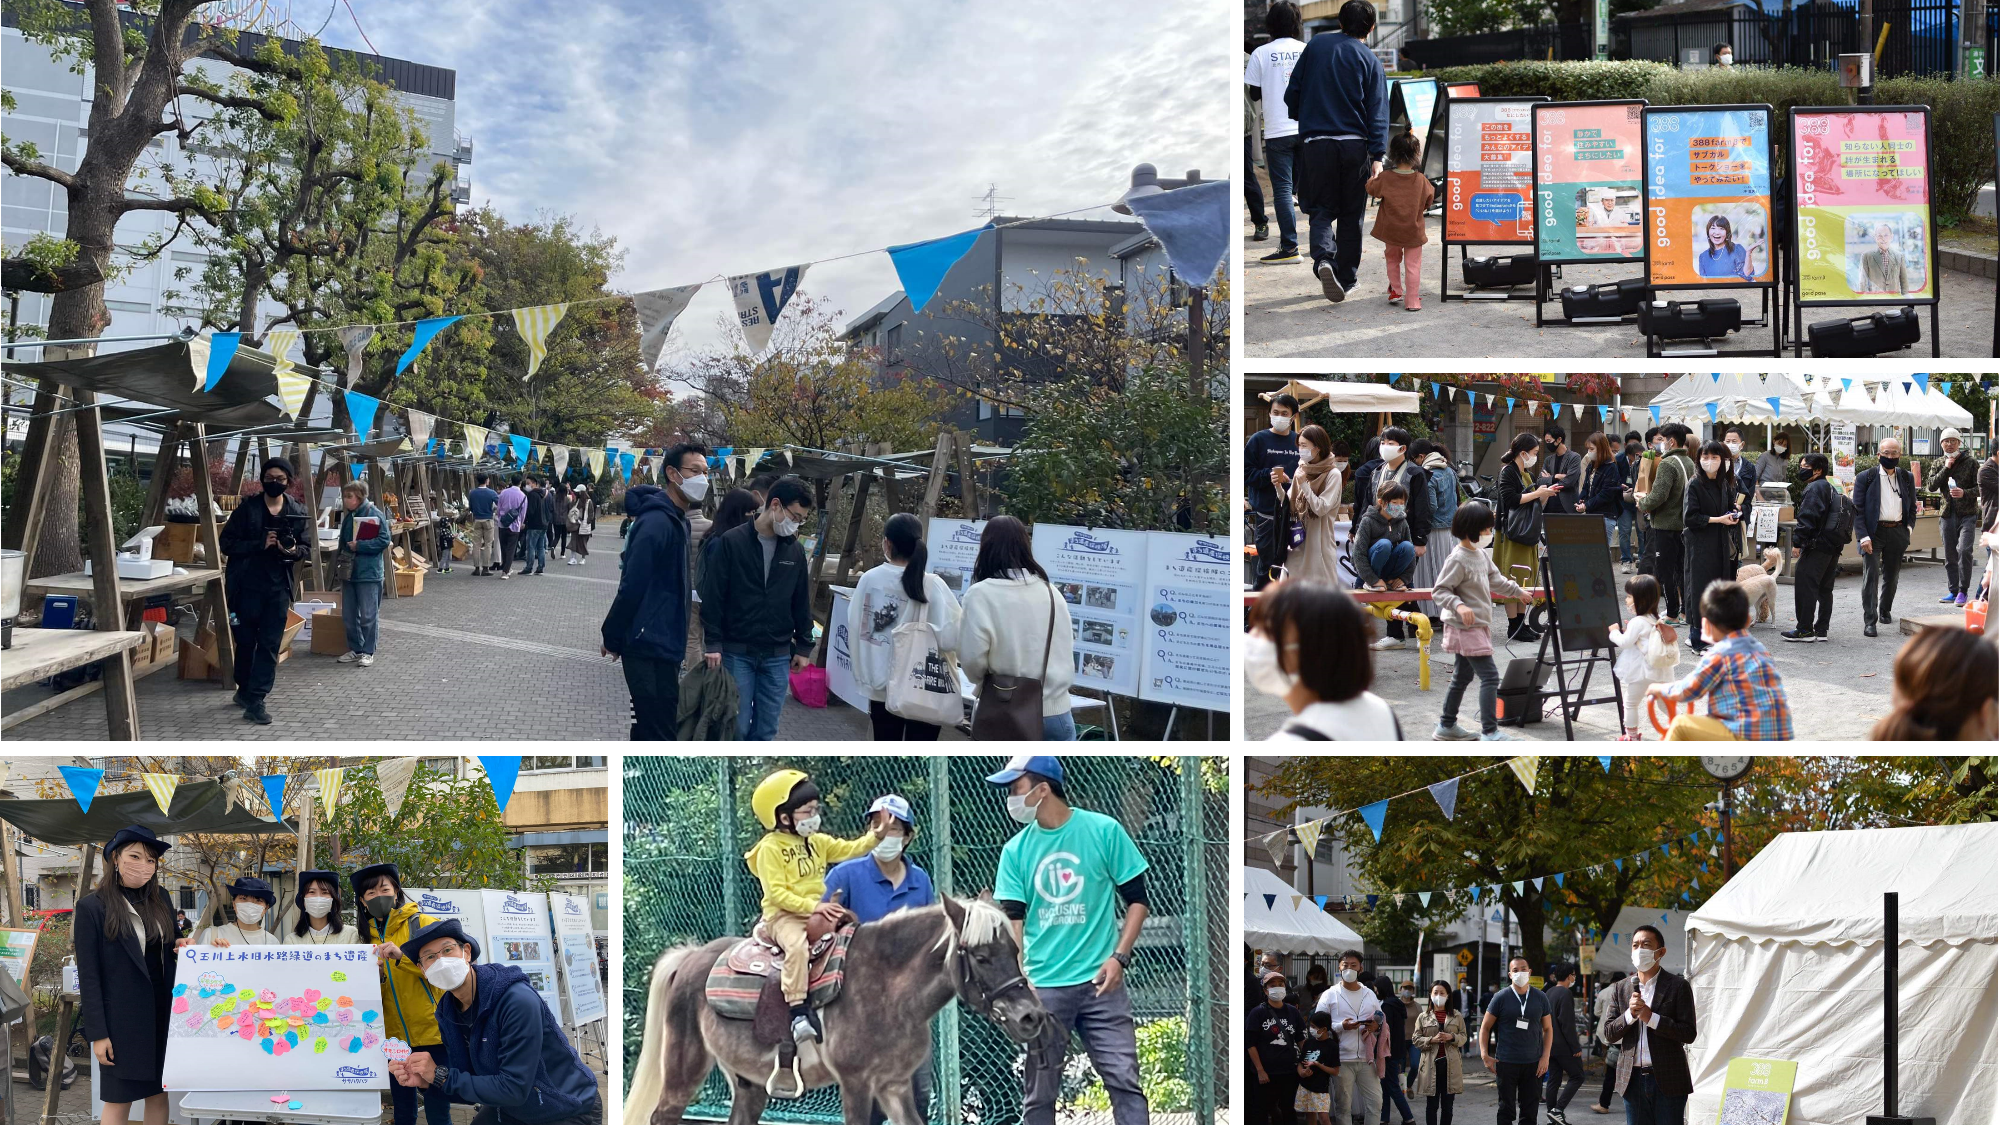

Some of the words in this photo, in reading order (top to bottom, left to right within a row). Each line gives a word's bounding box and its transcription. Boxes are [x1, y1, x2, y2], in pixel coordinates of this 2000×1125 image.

[1270, 52, 1302, 62] STAF
[1540, 111, 1566, 125] 388
[1651, 116, 1680, 132] 388
[1799, 118, 1830, 134] 388
[1450, 123, 1462, 140] for
[1540, 130, 1552, 149] for
[1650, 138, 1664, 158] for
[1798, 141, 1814, 164] for
[1844, 142, 1912, 150] 知らない人同士の
[1450, 145, 1462, 173] idea
[1578, 151, 1620, 159] まちにしたい
[1845, 156, 1897, 164] 絆が生まれる
[1538, 156, 1552, 185] idea
[1846, 169, 1922, 178] 場所になってほしい
[1649, 166, 1664, 200] idea
[1693, 176, 1746, 184] やってみたい!
[1448, 178, 1463, 210] good
[1798, 173, 1815, 208] idea
[1538, 191, 1556, 226] good
[1649, 205, 1670, 247] good
[1798, 216, 1820, 260] good
[928, 663, 939, 673] THE
[200, 951, 368, 962] 玉川上水旧水路緑道のまち遺産
